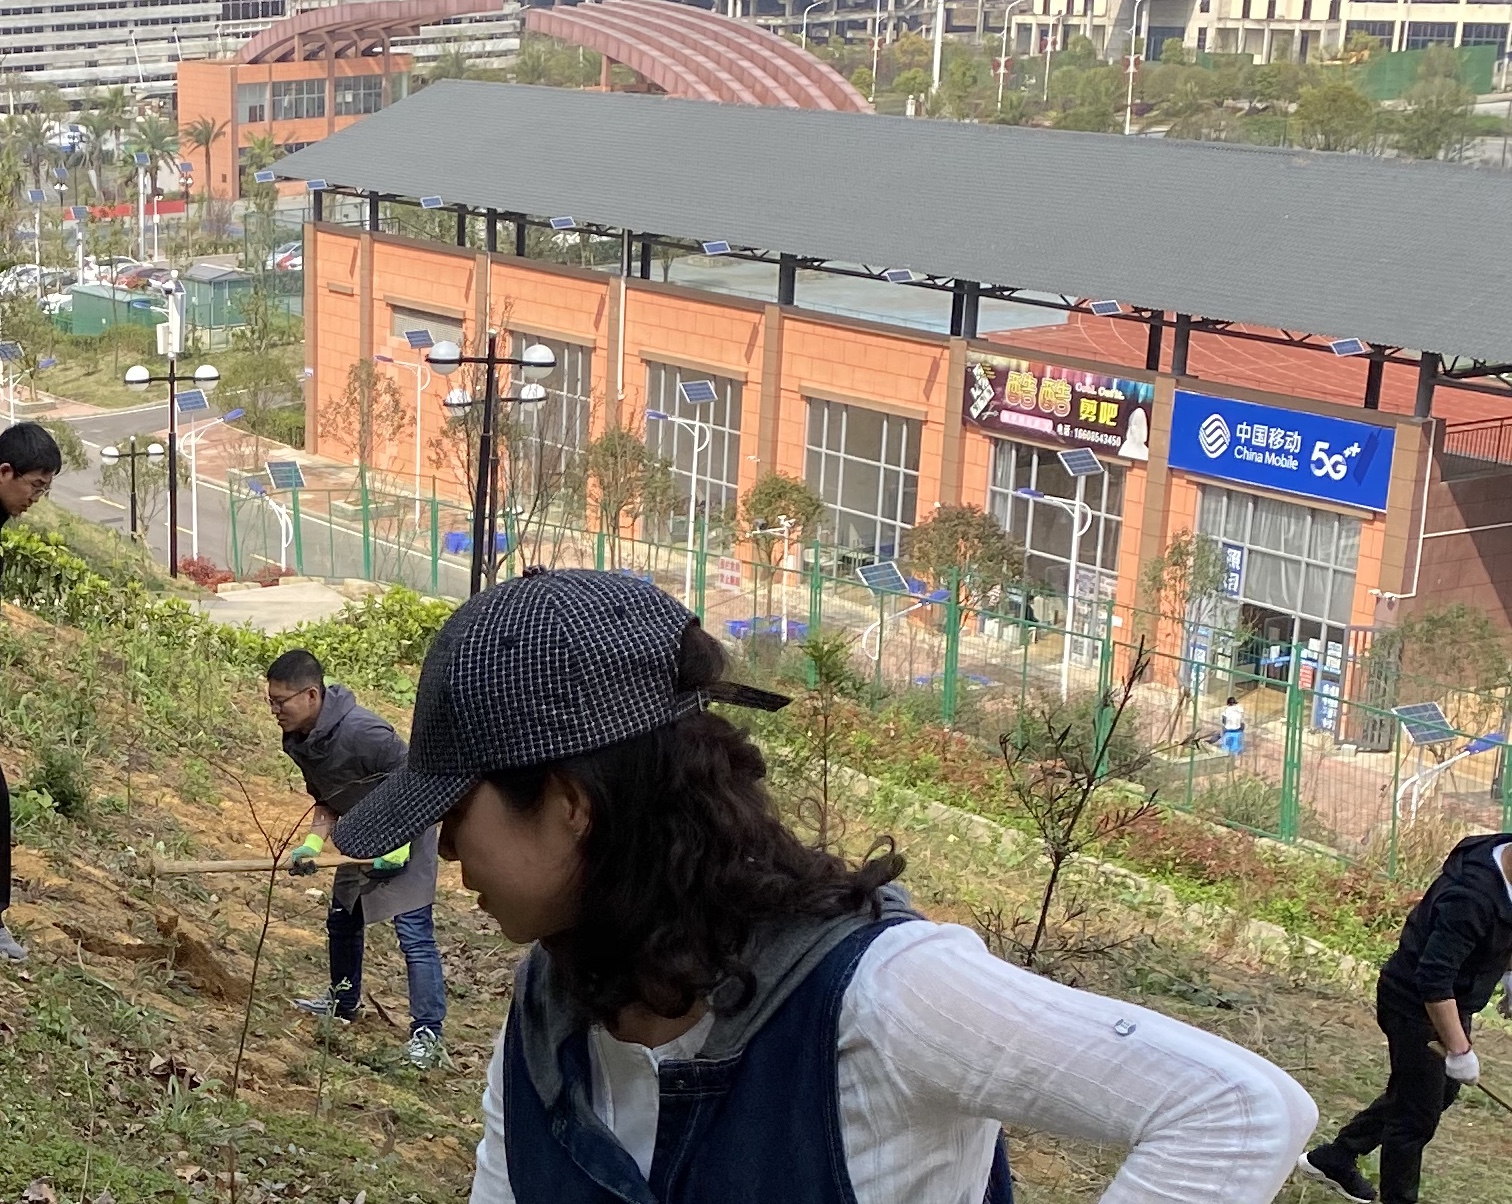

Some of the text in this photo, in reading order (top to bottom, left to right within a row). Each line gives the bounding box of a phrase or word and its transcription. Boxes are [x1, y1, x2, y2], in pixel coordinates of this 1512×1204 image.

[1005, 371, 1072, 417] 酷酷
[1079, 398, 1119, 426] 剪吧
[1236, 421, 1302, 453] 中国移动
[1234, 445, 1299, 470] China Mobile
